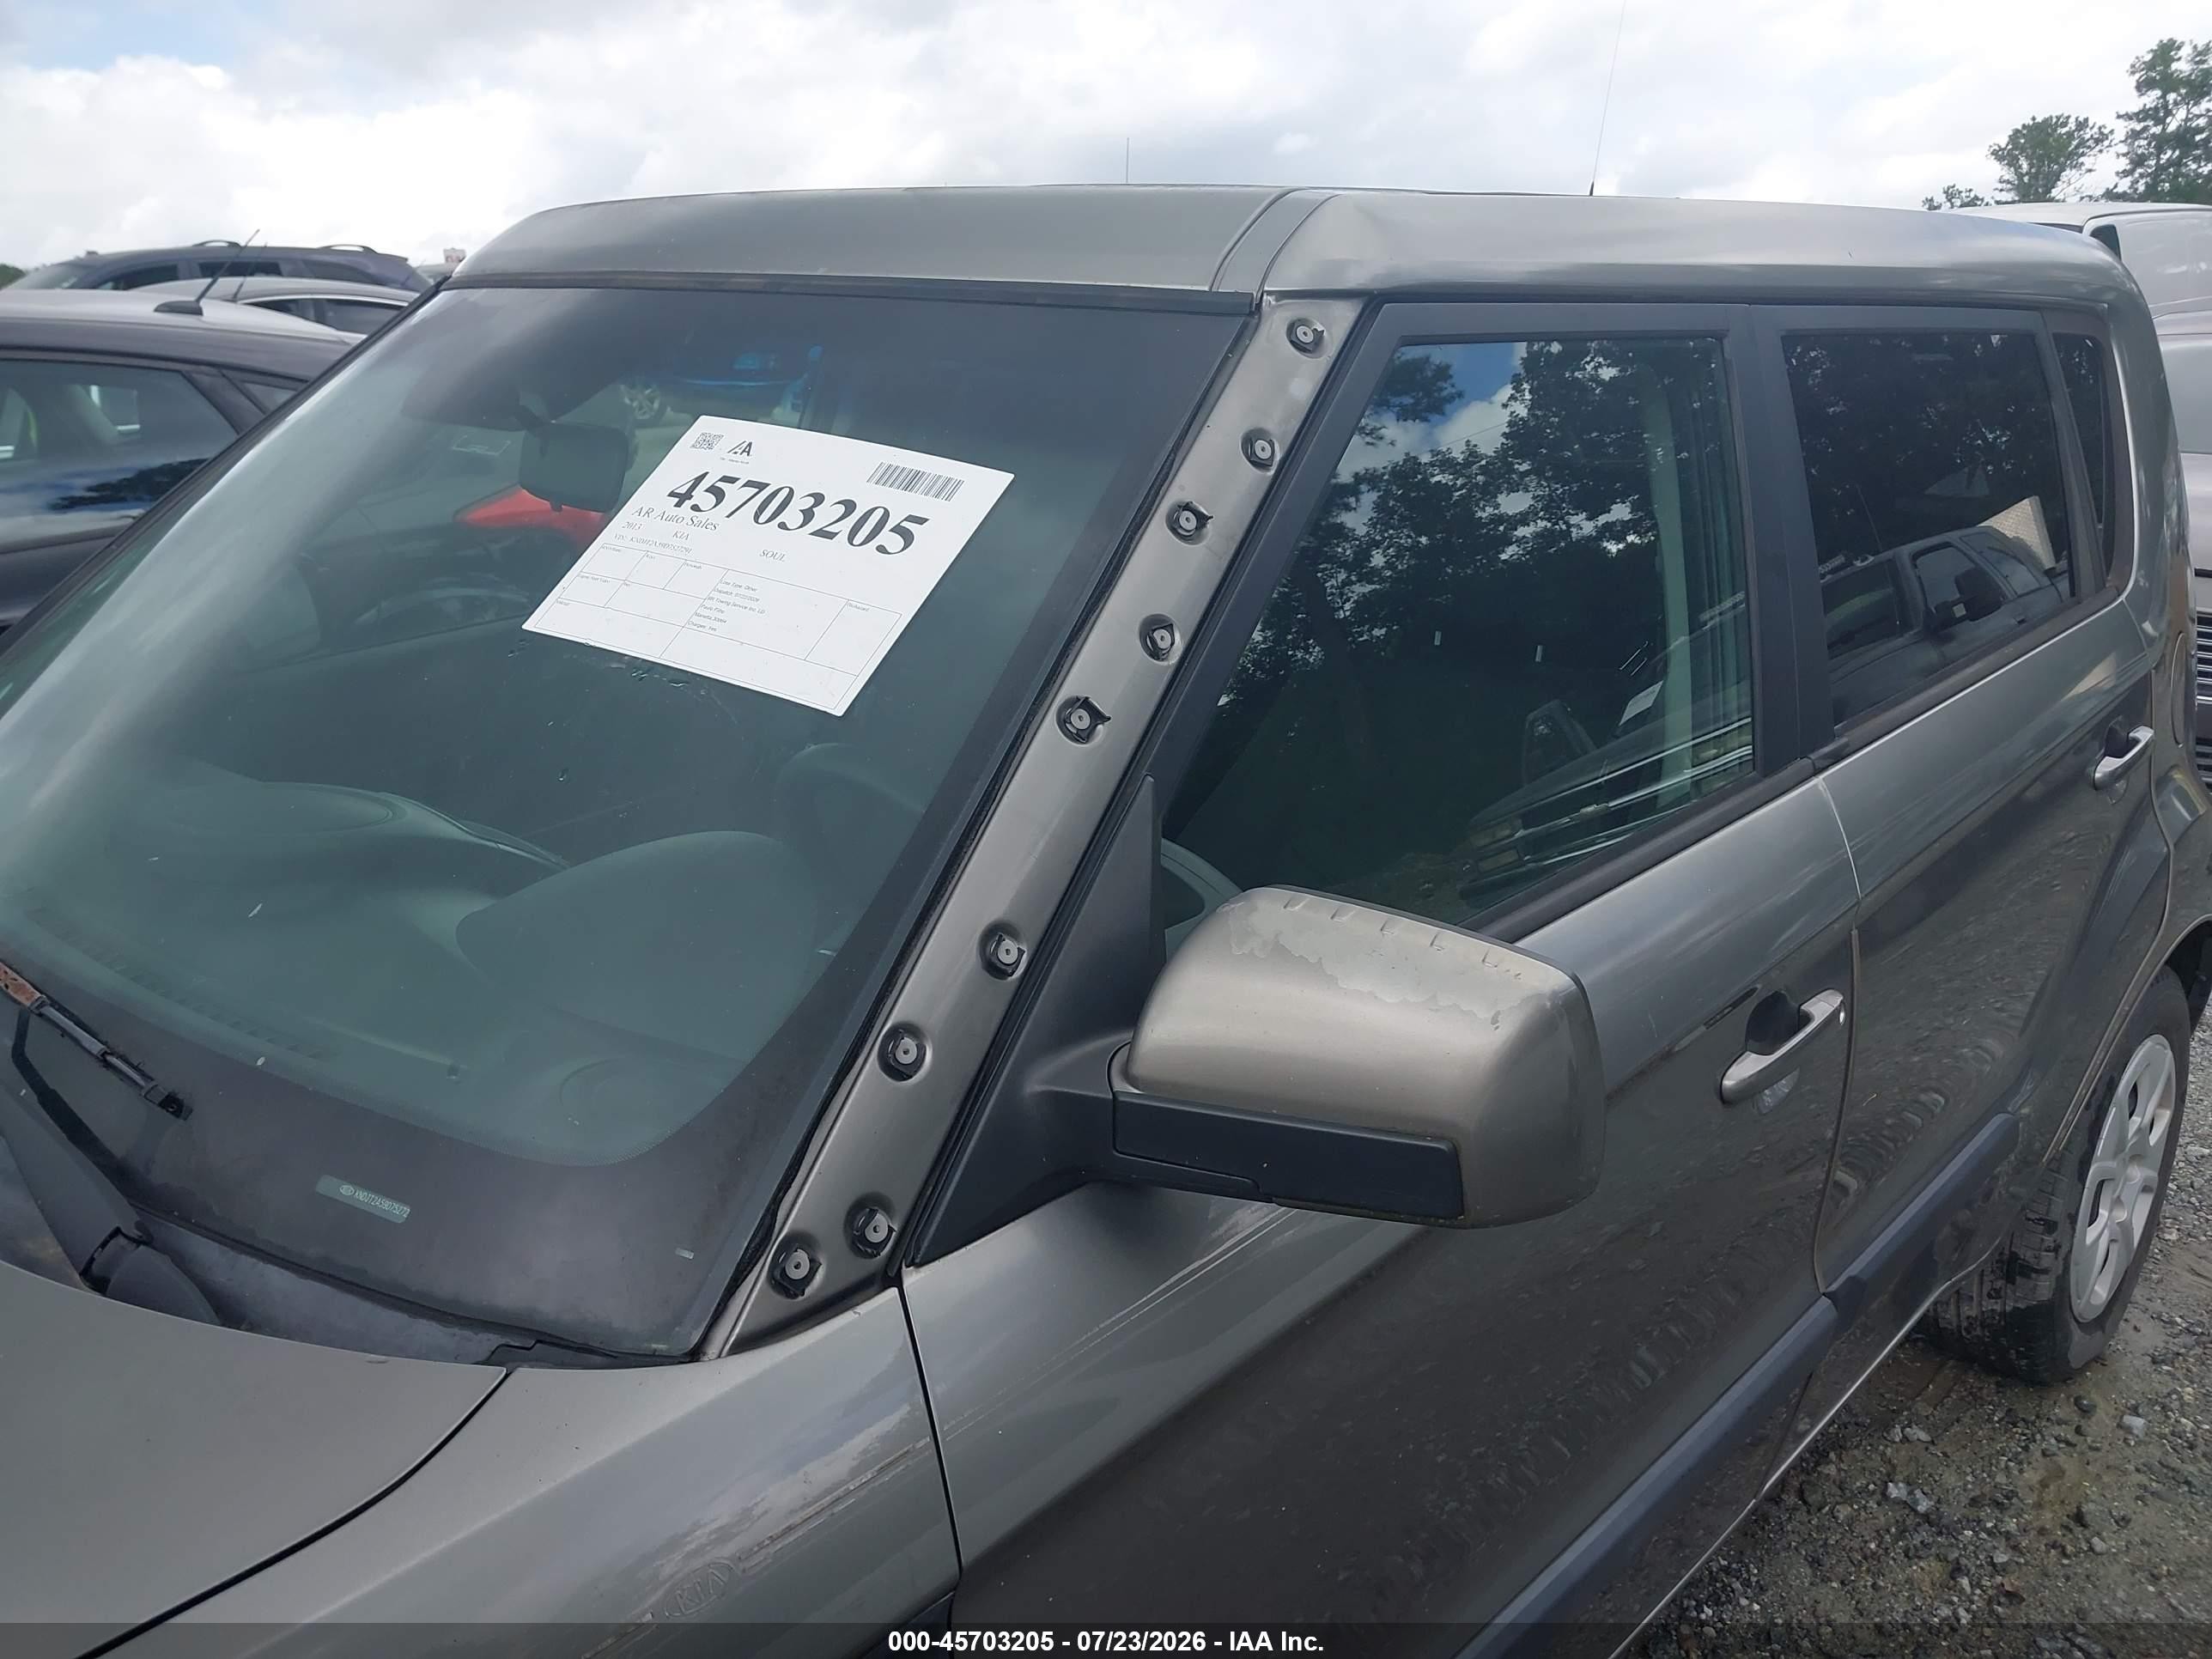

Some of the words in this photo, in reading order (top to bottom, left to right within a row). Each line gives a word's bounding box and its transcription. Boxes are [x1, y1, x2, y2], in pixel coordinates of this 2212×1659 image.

[632, 506, 654, 519] AR
[654, 510, 684, 524] Auto
[686, 515, 719, 531] Sales
[667, 471, 930, 555] 45703205
[622, 521, 644, 531] 2013
[672, 530, 690, 540] KIA
[759, 550, 786, 562] SOUL
